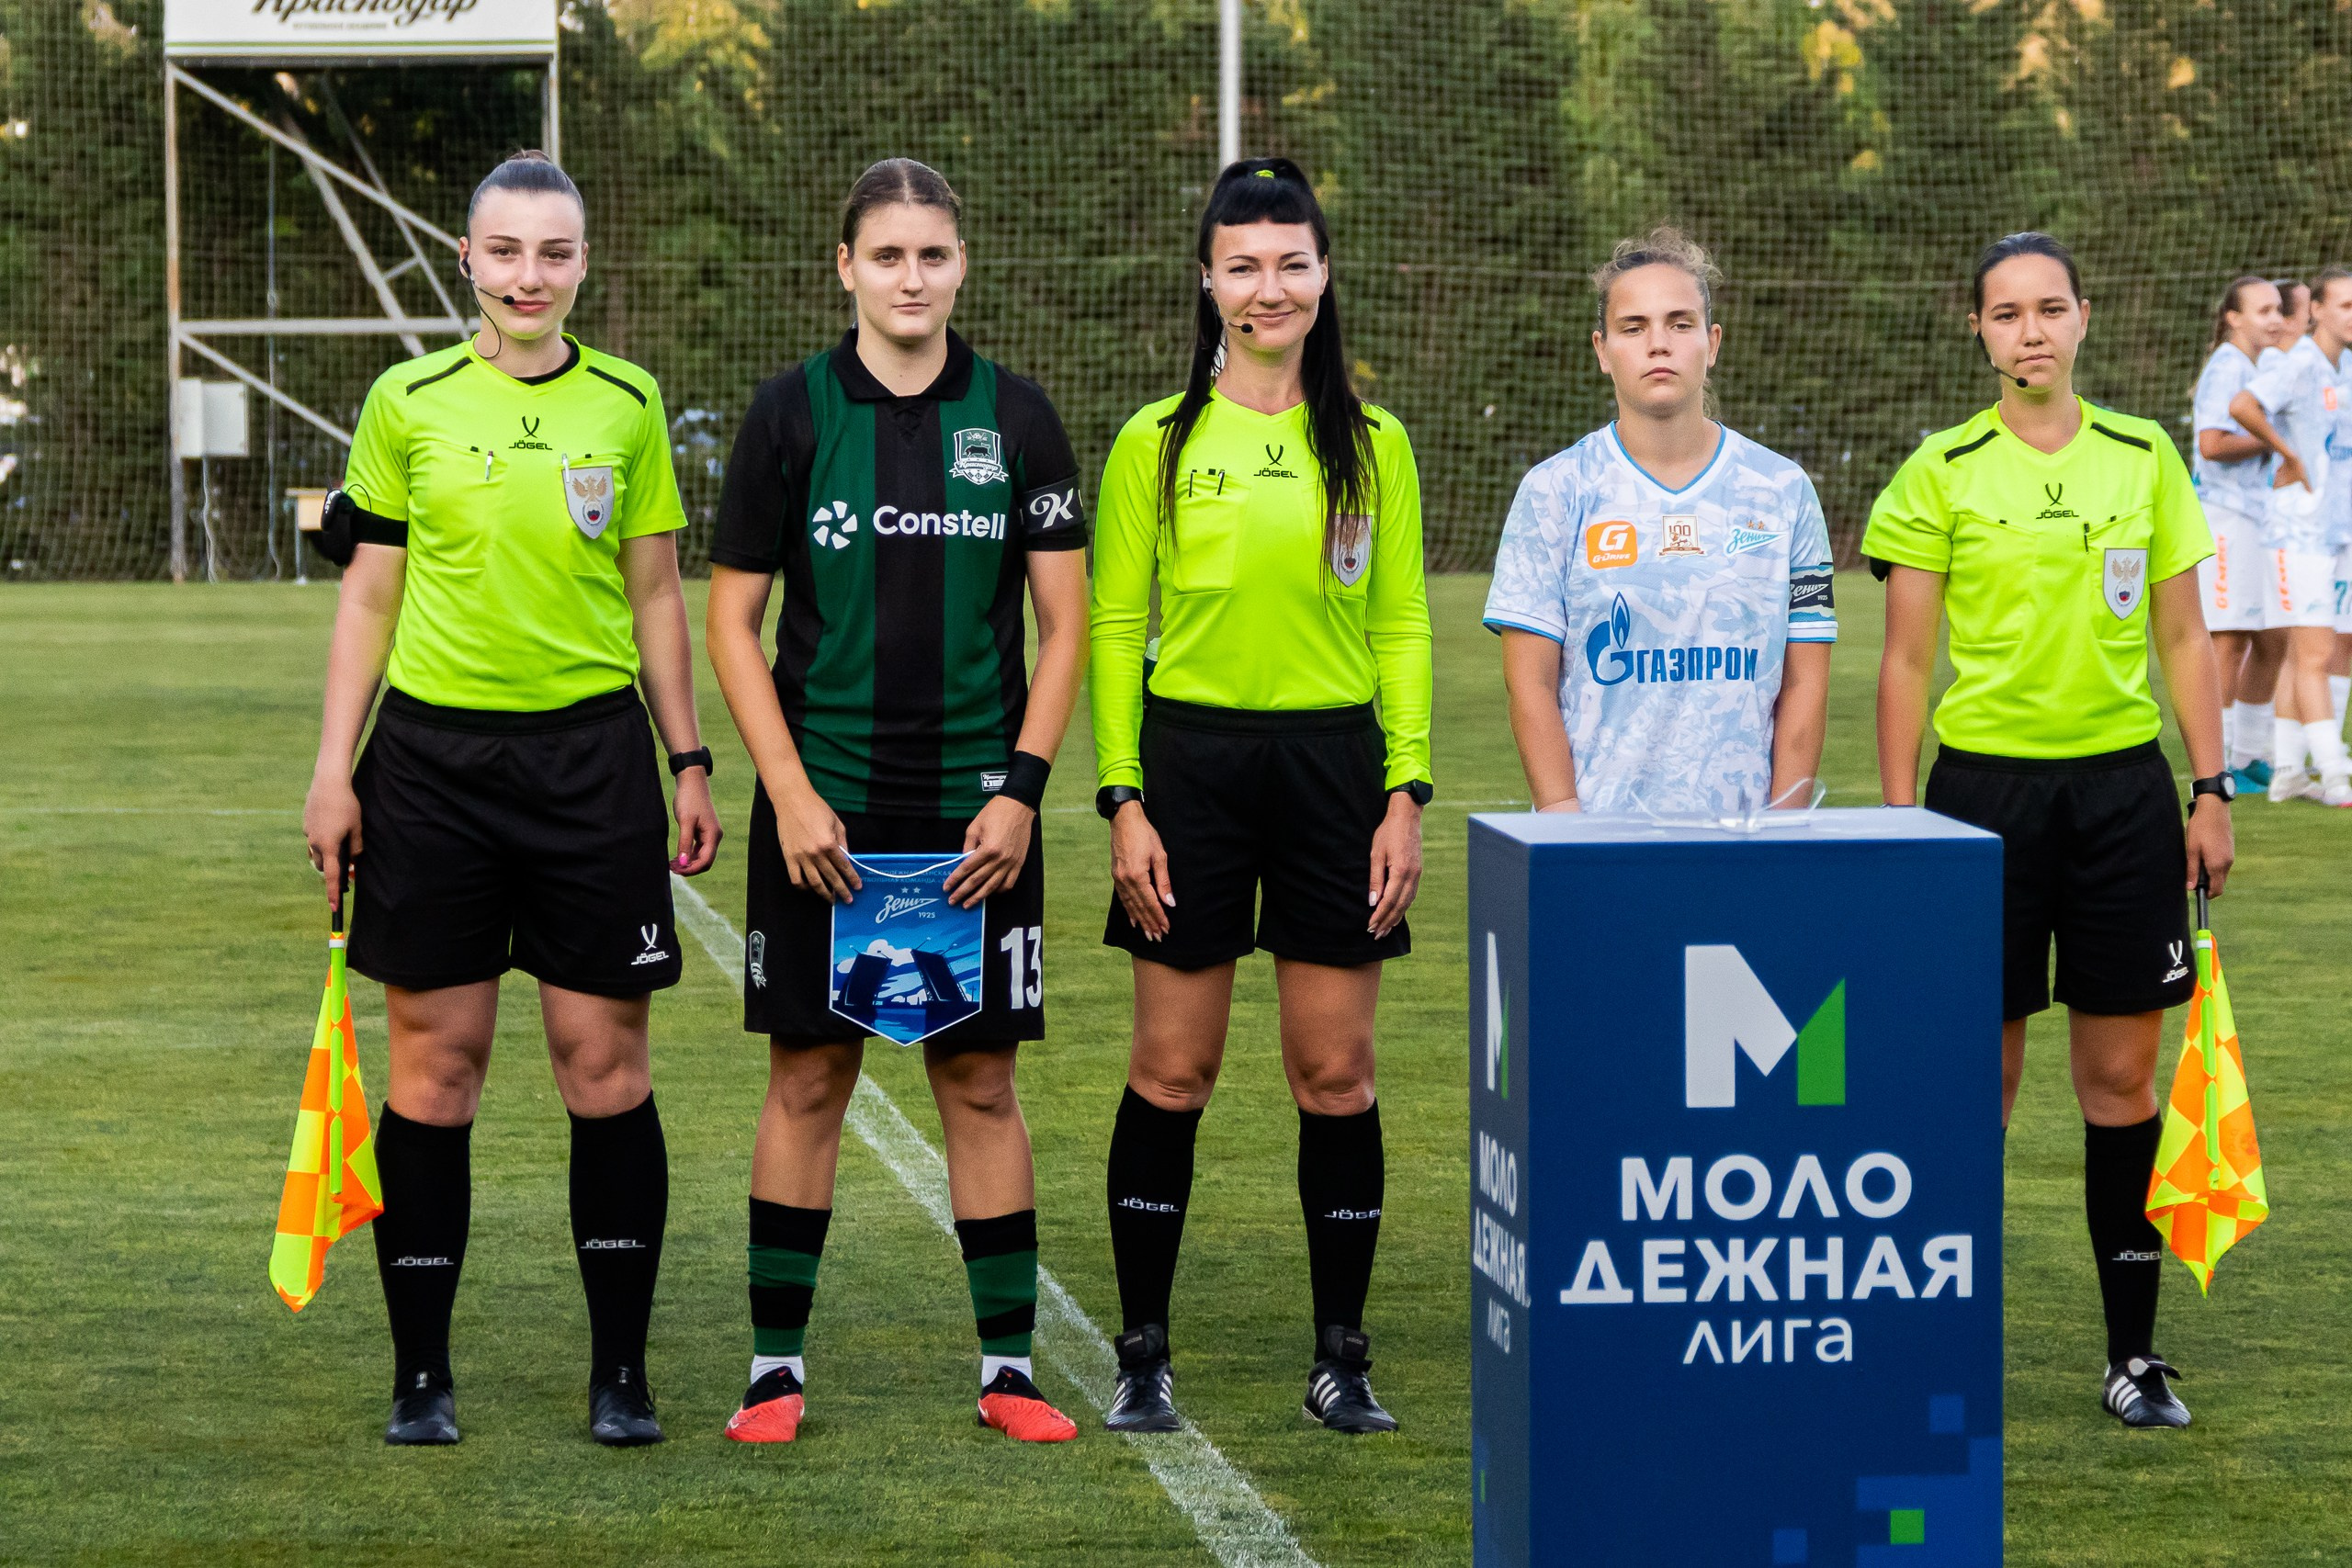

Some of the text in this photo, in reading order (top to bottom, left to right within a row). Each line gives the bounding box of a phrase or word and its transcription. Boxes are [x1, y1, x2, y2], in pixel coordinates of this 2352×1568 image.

[508, 439, 553, 451] JÖGEL
[1253, 468, 1298, 479] JÖGEL
[873, 505, 1006, 540] Constell
[2035, 510, 2080, 520] JÖGEL
[631, 951, 669, 965] JÖGEL
[1001, 926, 1043, 1010] 13
[1479, 1130, 1518, 1217] МОЛО
[1622, 1152, 1913, 1222] МОЛО
[1117, 1197, 1180, 1213] JÖGEL
[580, 1238, 646, 1249] JÖGEL
[390, 1256, 454, 1266] JÖGEL
[1559, 1234, 1973, 1304] ДЕЖНАЯ
[1682, 1315, 1854, 1365] лига
